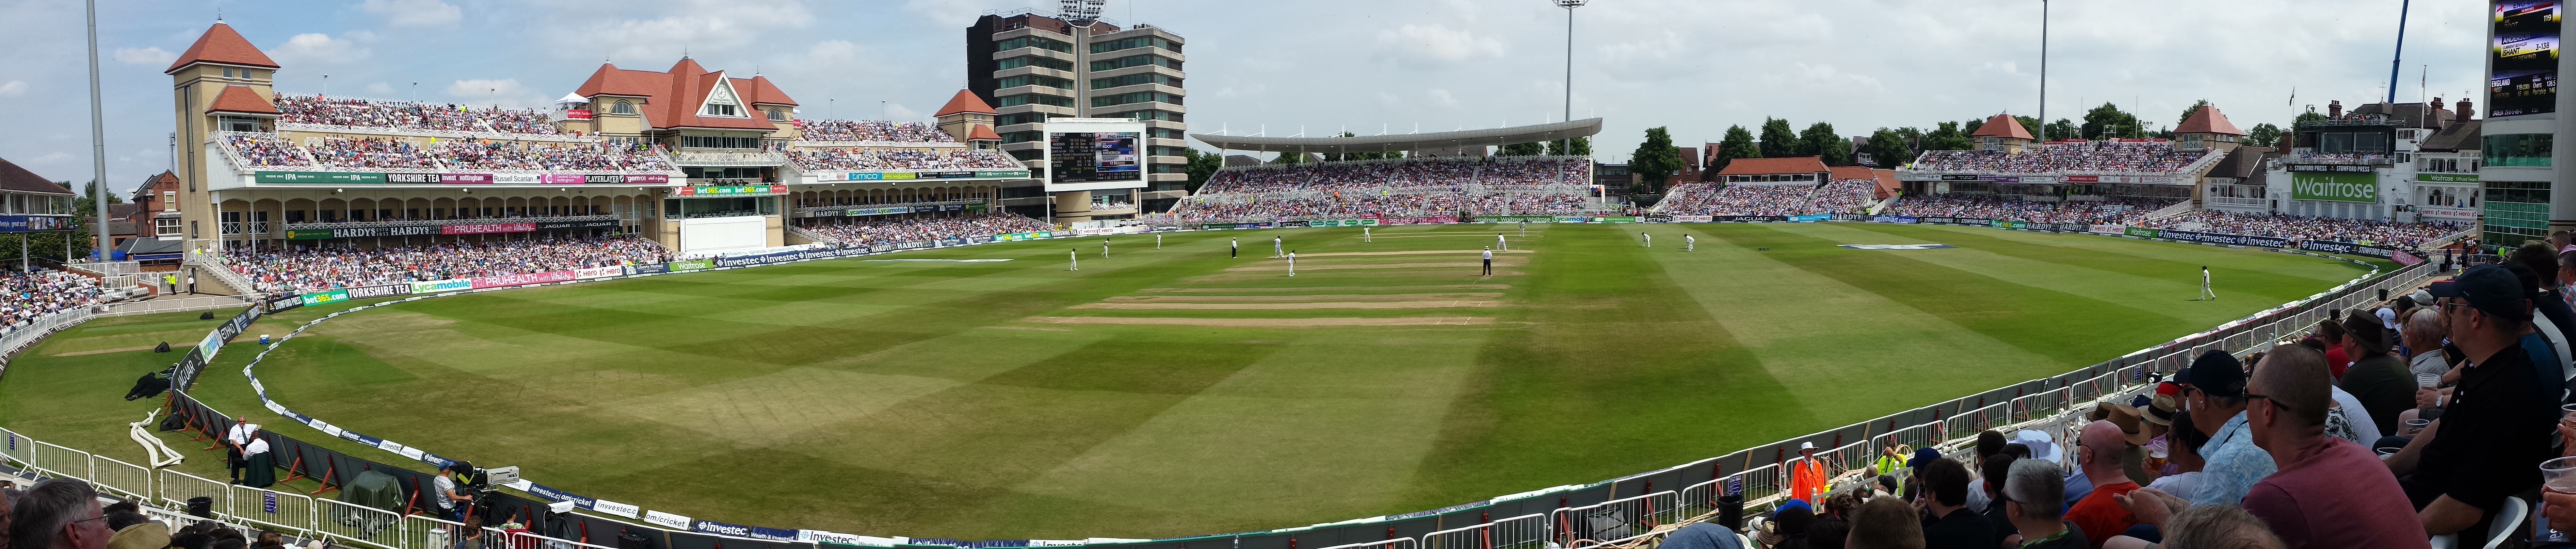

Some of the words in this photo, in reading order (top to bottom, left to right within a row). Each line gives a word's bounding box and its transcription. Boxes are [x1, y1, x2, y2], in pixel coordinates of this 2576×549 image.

[2503, 48, 2520, 56] ISHANT
[2492, 79, 2510, 87] ENGLAND
[388, 174, 426, 182] YORKSHIRE
[427, 174, 440, 182] TEA
[442, 174, 493, 182] investinnottingham.com
[2294, 176, 2374, 198] Waitrose
[334, 228, 375, 238] HARDYS
[391, 226, 429, 236] HARDYS
[454, 224, 501, 233] PRUHEALTH
[514, 223, 535, 231] Vitality
[2131, 228, 2151, 236] Waitrose
[2163, 231, 2195, 240] Investec
[2247, 237, 2284, 247] Investec
[2309, 241, 2350, 253] Investec
[804, 251, 835, 259] Investec
[841, 248, 869, 256] Investec
[2358, 247, 2380, 256] STOWFORD
[2380, 248, 2393, 257] PRESS
[724, 257, 760, 267] Investec
[766, 254, 798, 263] Investec
[677, 262, 706, 270] Waitrose
[486, 274, 537, 286] PRUHEALTH
[551, 272, 573, 280] Vitality
[348, 286, 394, 298] YORKSHIRE
[394, 284, 411, 295] TEA
[412, 279, 471, 293] Lycamobile
[274, 299, 292, 310] STOWFORD
[292, 296, 302, 306] PRESS
[305, 292, 347, 304] bet365.com
[221, 323, 235, 340] ETIHAD
[201, 332, 217, 361] Lycamobile
[177, 360, 195, 392] JAGUAR
[345, 430, 360, 441] Investec
[384, 442, 401, 451] Investec
[646, 513, 685, 527] om/cricket
[706, 522, 747, 536] Investec
